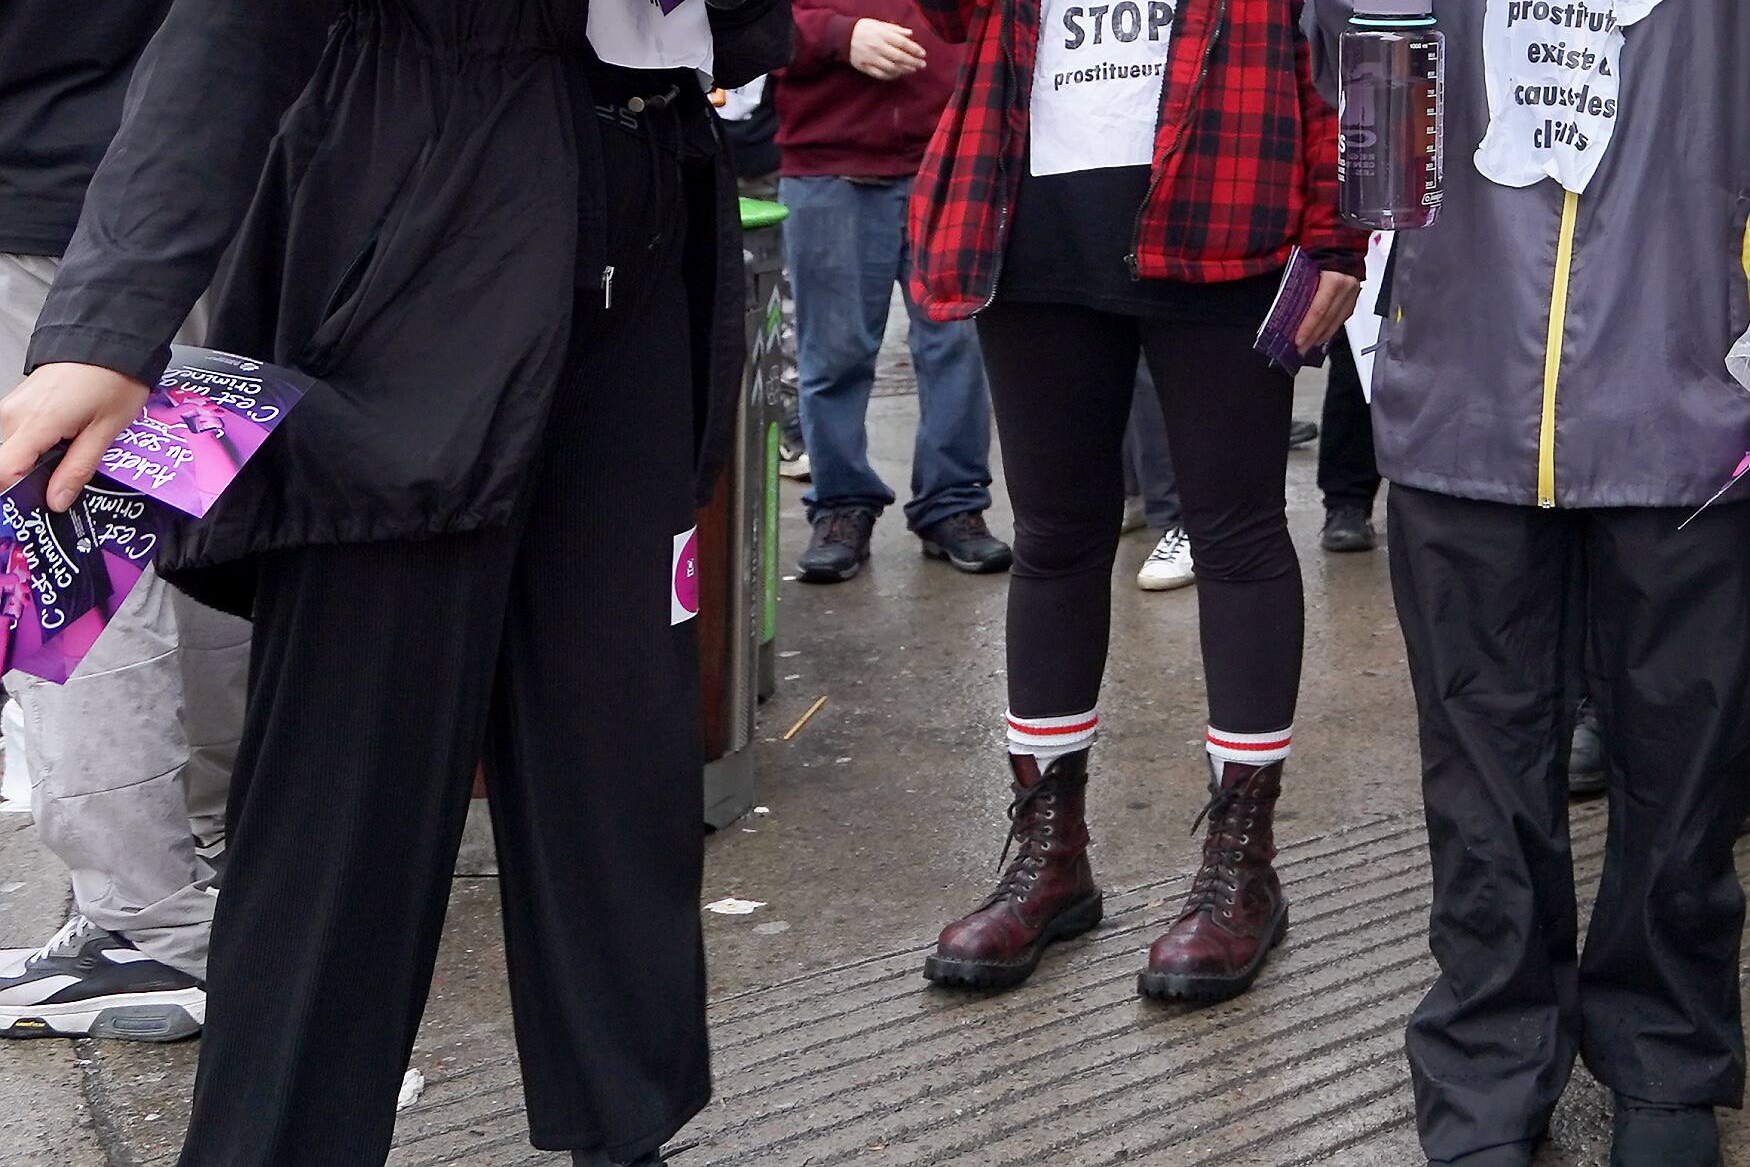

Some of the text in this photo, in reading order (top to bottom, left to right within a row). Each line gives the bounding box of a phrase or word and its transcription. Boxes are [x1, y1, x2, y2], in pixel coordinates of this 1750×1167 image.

[1063, 0, 1174, 50] STOP
[180, 381, 211, 396] un
[101, 447, 177, 489] Achete
[165, 444, 194, 469] du
[2, 497, 30, 542] acte
[23, 542, 40, 570] un
